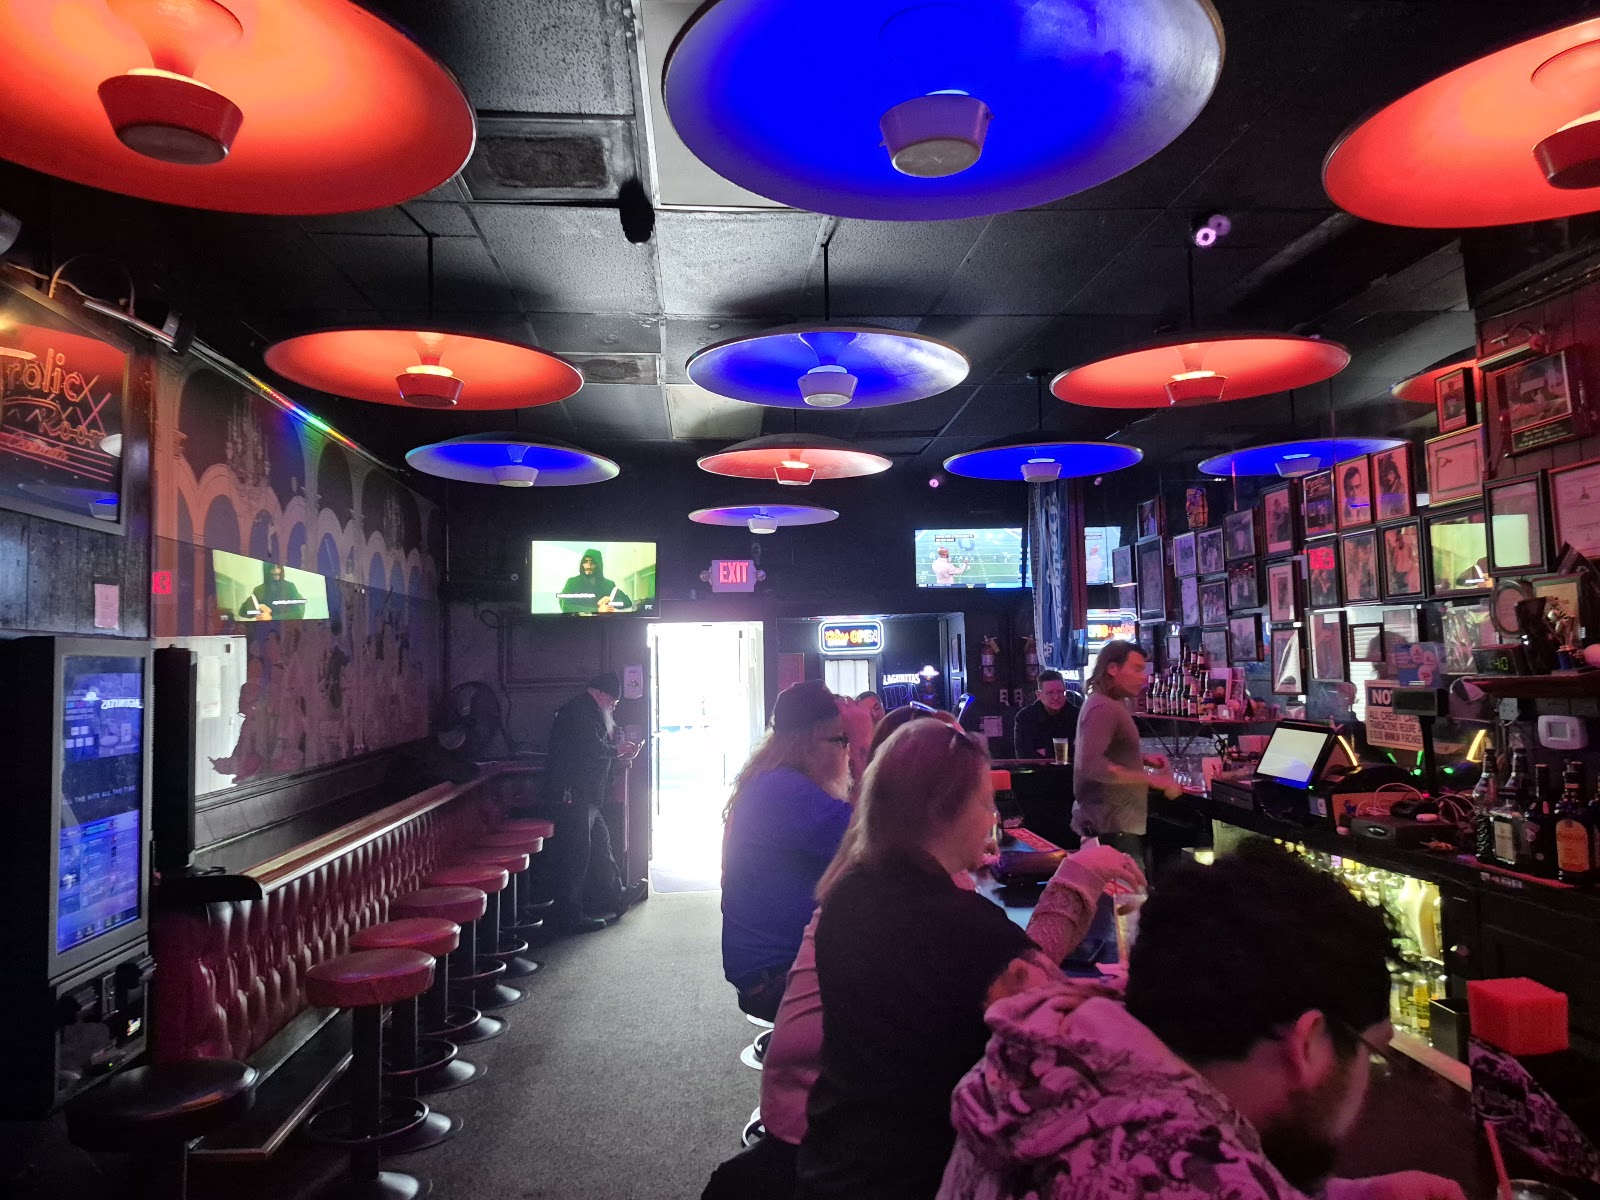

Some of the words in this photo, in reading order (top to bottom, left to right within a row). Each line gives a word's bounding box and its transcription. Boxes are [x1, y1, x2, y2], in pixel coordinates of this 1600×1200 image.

[718, 561, 749, 584] EXIT
[849, 629, 878, 643] OPEN
[883, 673, 921, 686] LAGUNITAS
[1372, 689, 1393, 705] NO
